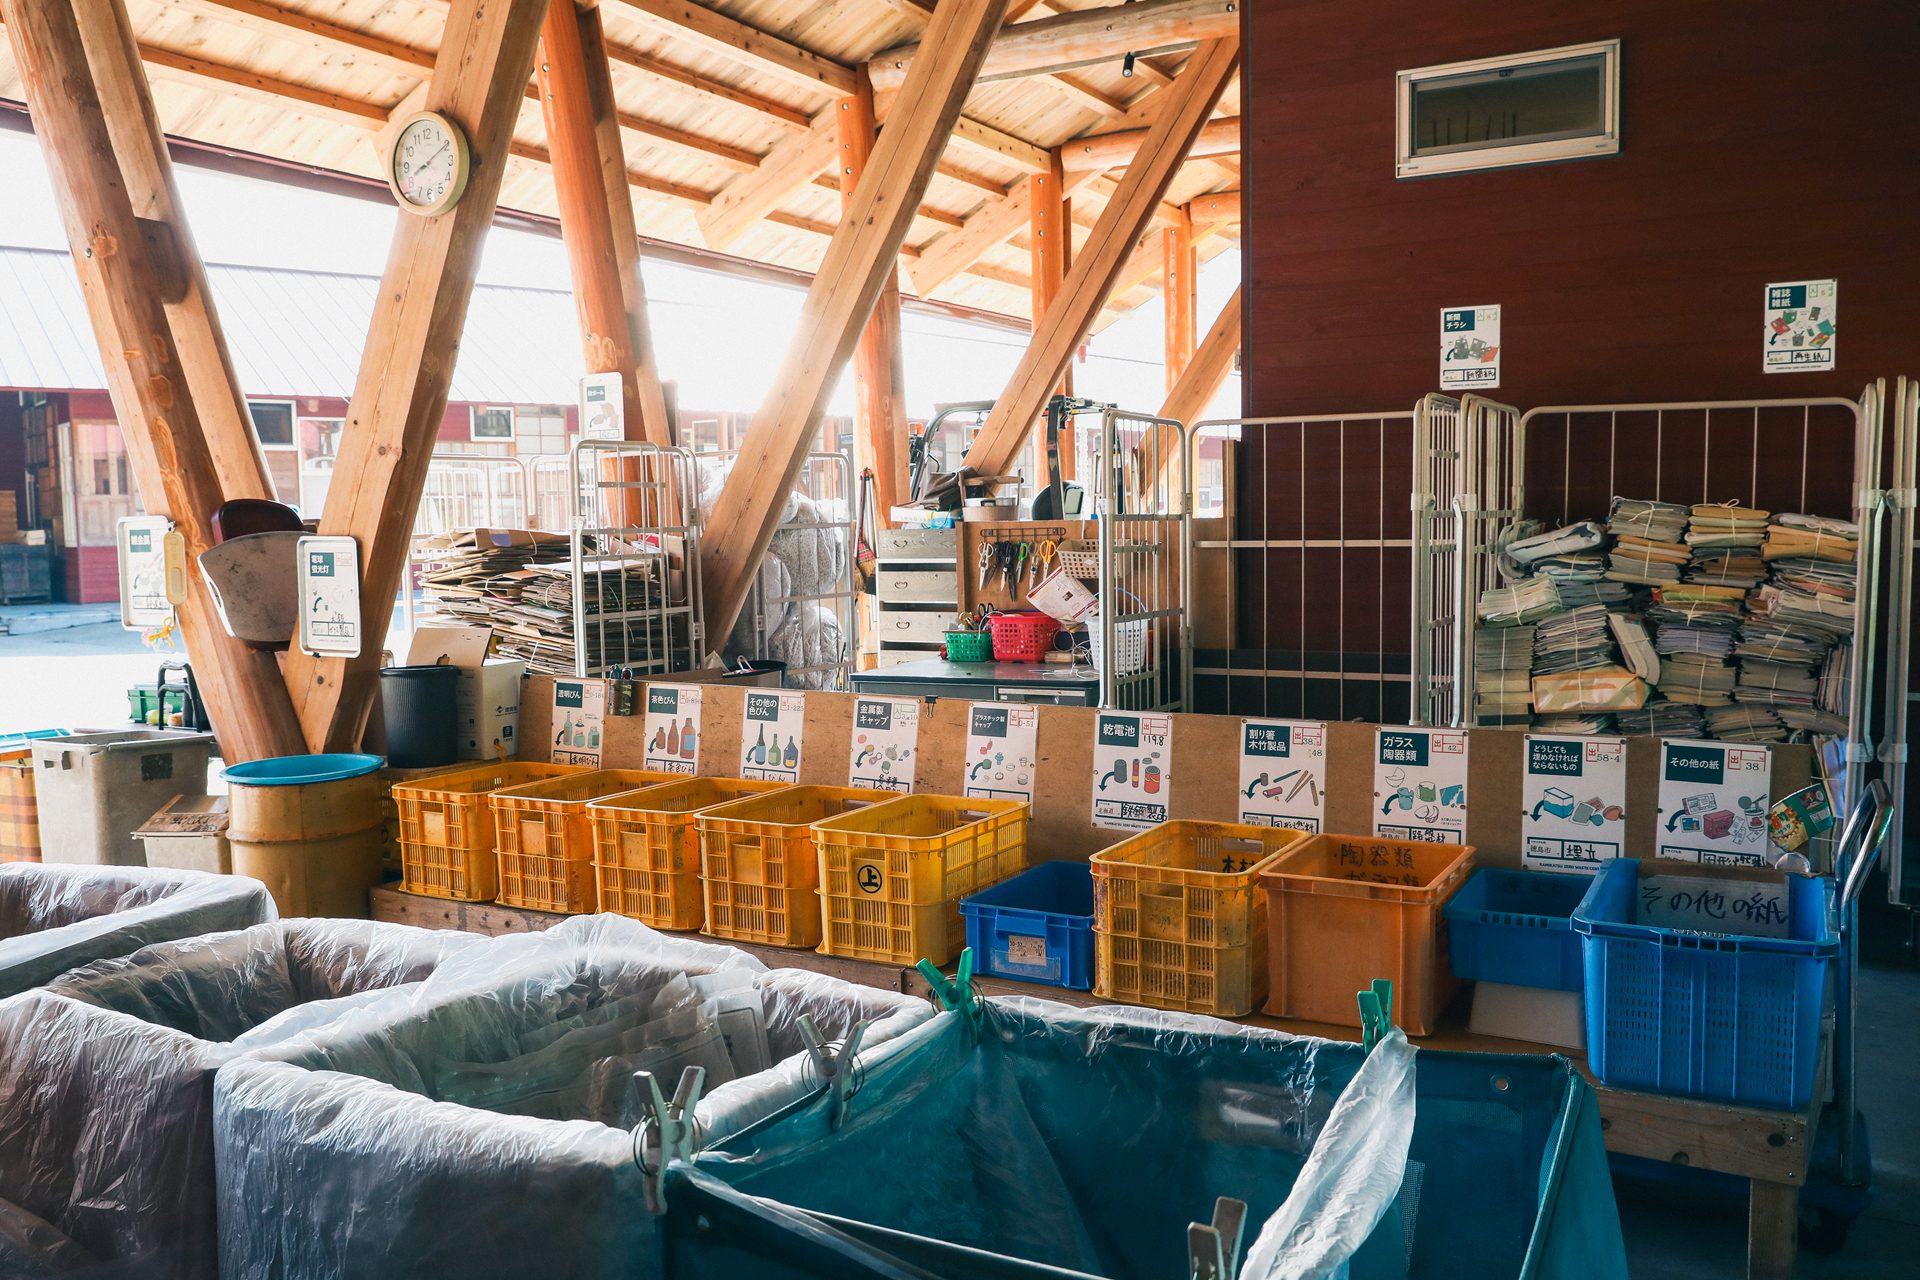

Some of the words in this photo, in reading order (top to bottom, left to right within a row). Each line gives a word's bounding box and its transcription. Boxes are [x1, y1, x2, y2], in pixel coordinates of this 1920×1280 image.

[413, 134, 422, 145] 11
[422, 128, 432, 140] 12
[436, 130, 440, 142] 1
[444, 139, 451, 152] 2
[406, 146, 415, 158] 10
[447, 155, 454, 167] 3
[403, 161, 410, 174] 9
[408, 176, 415, 189] 8
[445, 171, 452, 182] 4
[417, 187, 424, 198] 7
[426, 188, 433, 201] 6
[437, 183, 445, 195] 5
[1446, 321, 1467, 330] チラシ
[558, 689, 581, 699] 透明びん
[651, 695, 676, 705] 茶色びん
[749, 697, 777, 708] その他の
[748, 706, 770, 717] 色びん
[859, 703, 885, 716] 金属製
[859, 715, 890, 727] キャップ
[974, 722, 992, 730] キャップ
[1103, 723, 1136, 738] 乾電池
[1248, 728, 1276, 741] 割り箸
[1248, 740, 1287, 753] 木竹製品
[1383, 736, 1414, 749] ガラス
[1447, 744, 1457, 752] 42
[1533, 744, 1567, 754] どうしても
[1383, 748, 1418, 763] 陶器類
[1532, 753, 1579, 764] 埋めなければ
[1532, 761, 1578, 772] ならないもの
[1669, 757, 1720, 771] その他の紙
[1745, 761, 1760, 771] 38
[1641, 886, 1788, 926] その他の紙
